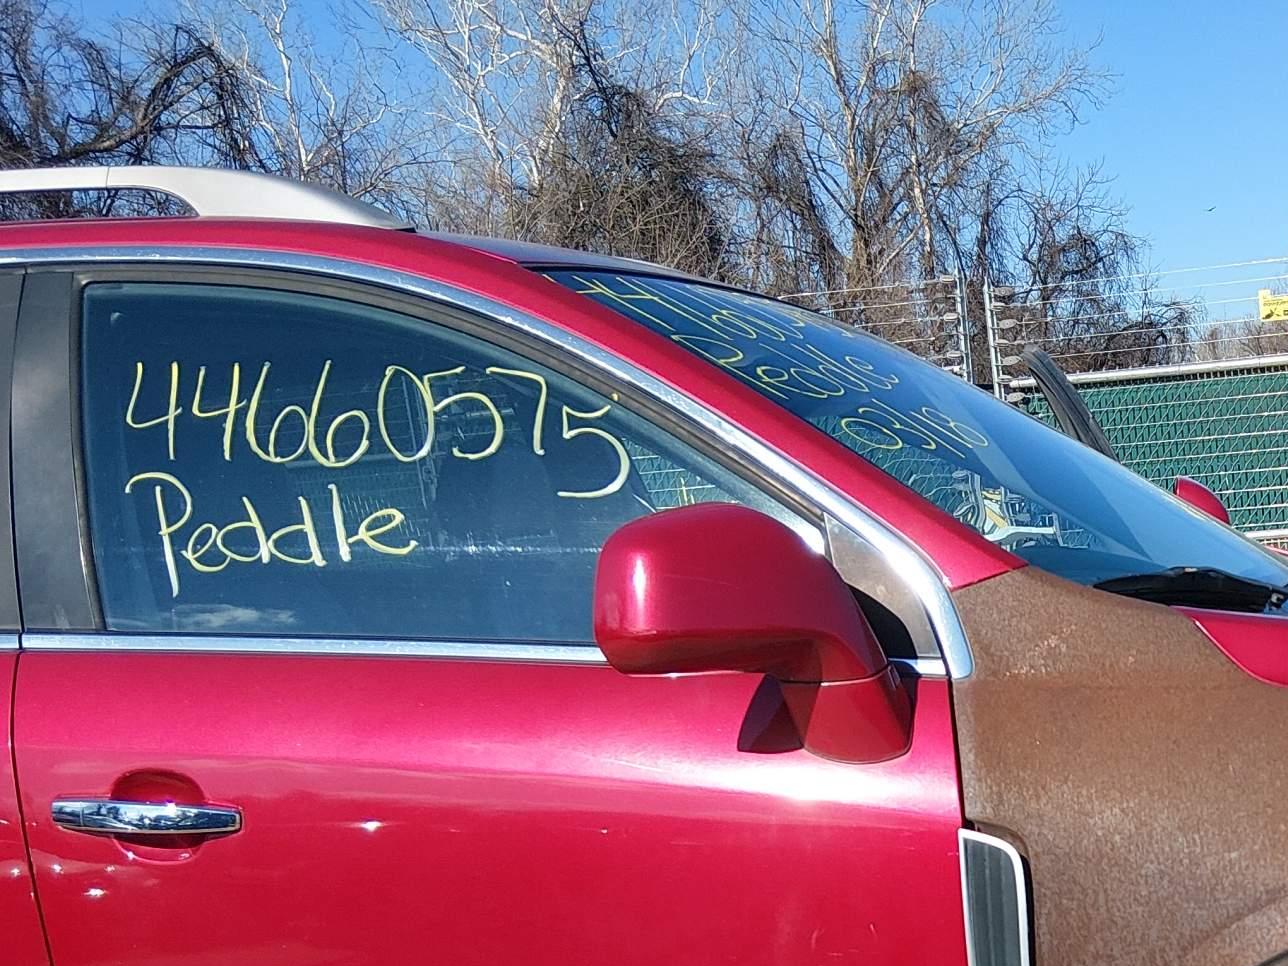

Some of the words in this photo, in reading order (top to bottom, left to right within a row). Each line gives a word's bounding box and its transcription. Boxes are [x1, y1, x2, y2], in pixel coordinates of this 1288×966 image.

[670, 333, 899, 400] Peddle
[125, 359, 635, 498] 44660575
[840, 398, 989, 459] 03/18
[123, 470, 419, 598] Peddle
